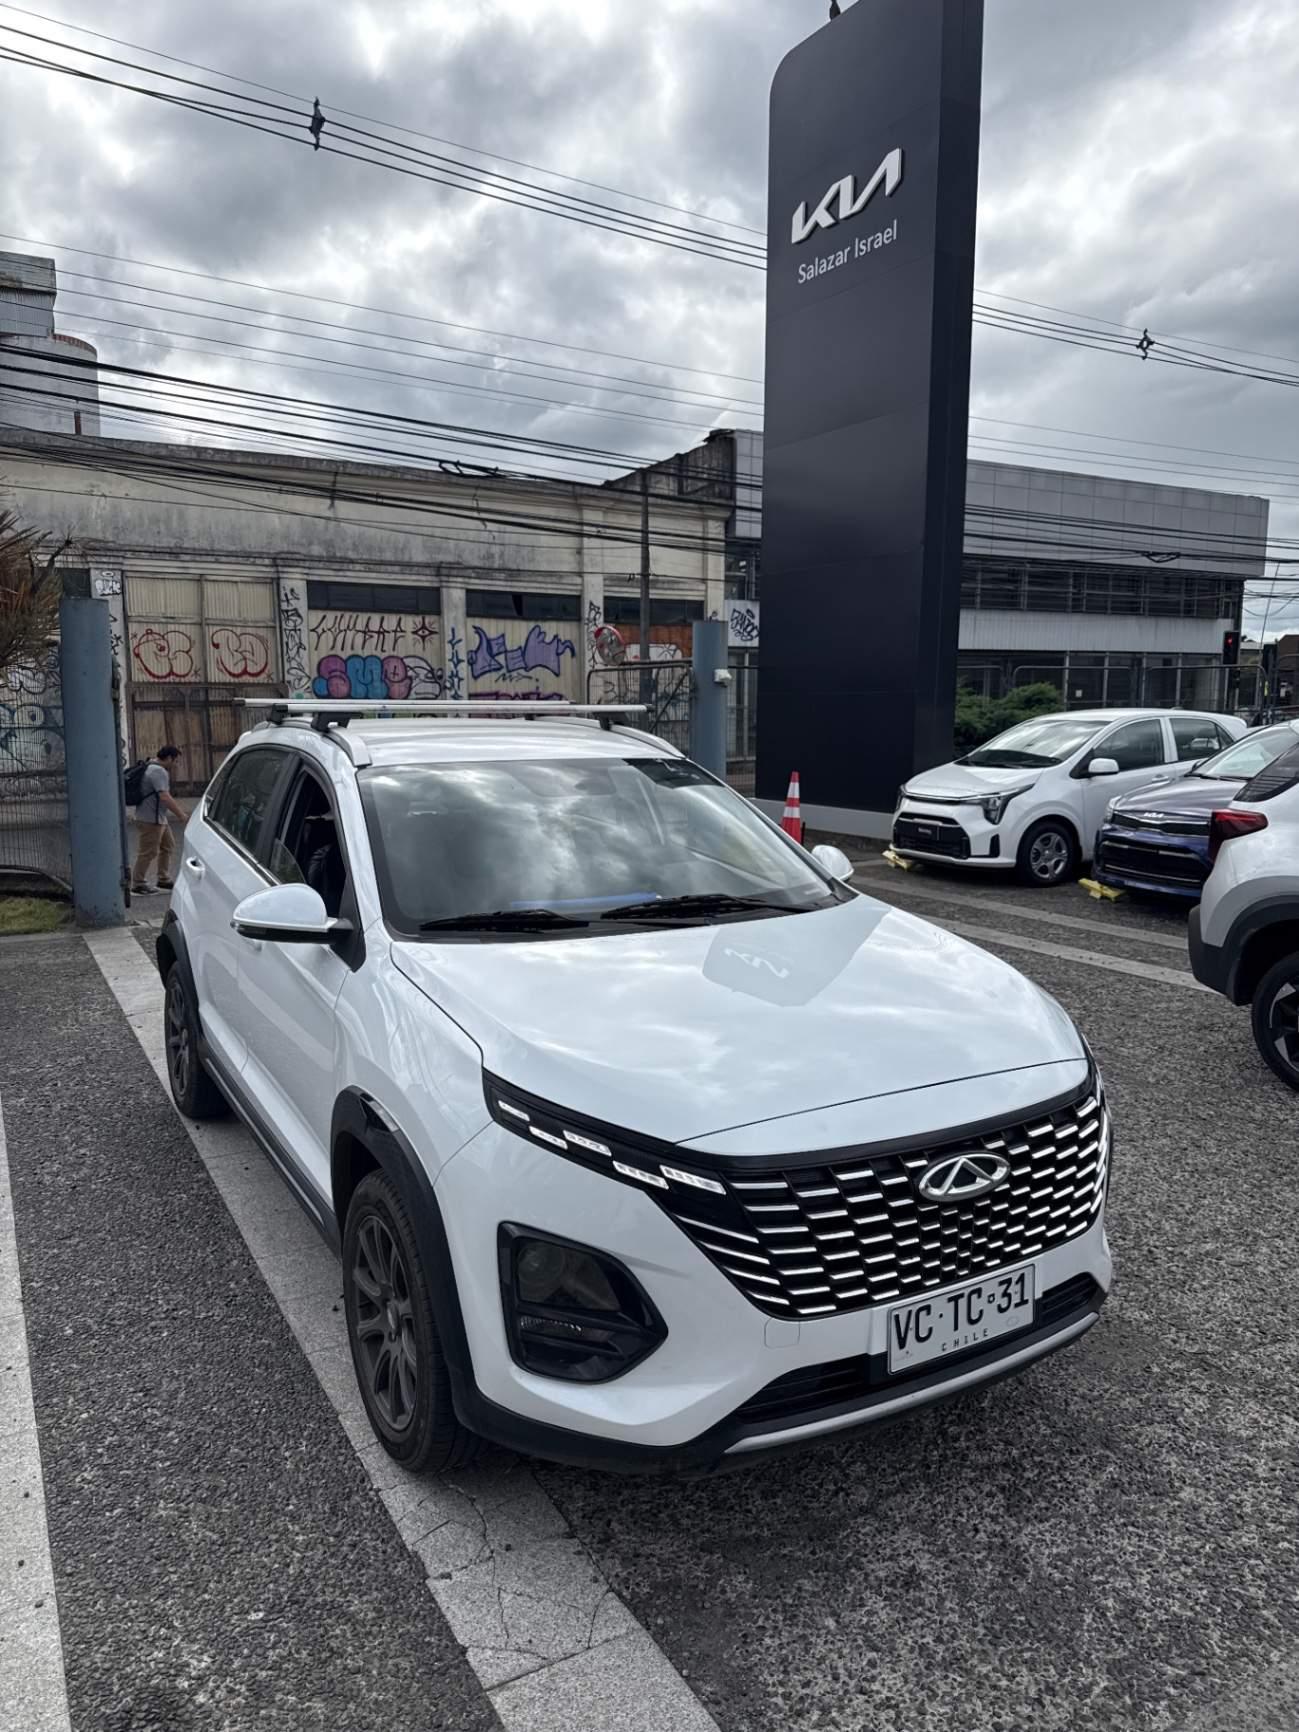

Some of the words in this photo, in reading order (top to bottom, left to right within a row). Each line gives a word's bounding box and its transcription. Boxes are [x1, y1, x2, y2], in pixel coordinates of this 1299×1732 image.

[791, 147, 902, 244] KIA
[798, 246, 851, 284] Salazar
[854, 219, 898, 259] Israel
[941, 1327, 989, 1352] CHILE
